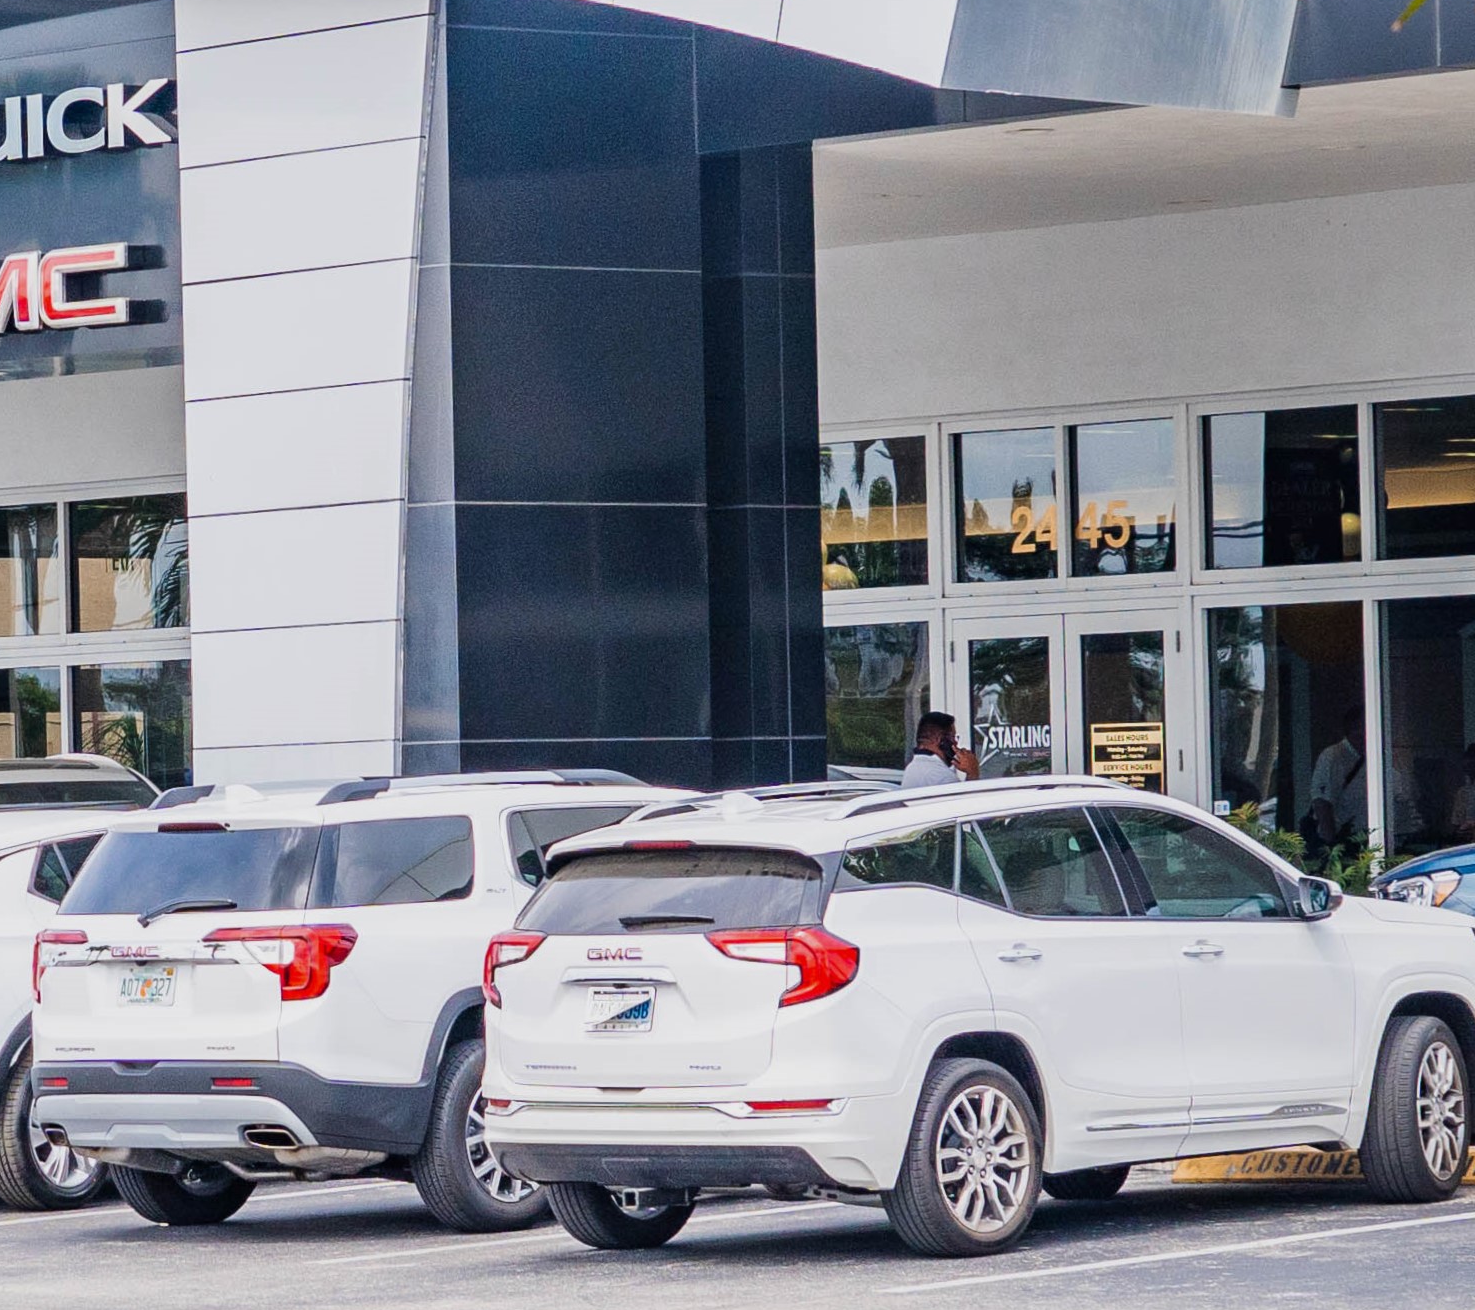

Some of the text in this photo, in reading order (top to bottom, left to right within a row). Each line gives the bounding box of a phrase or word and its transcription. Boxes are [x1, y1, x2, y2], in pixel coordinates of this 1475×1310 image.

[988, 725, 1050, 749] STARLING
[1106, 733, 1149, 742] SALES HOURS
[1103, 763, 1153, 772] SERVICE HOURS
[111, 946, 160, 958] GMC
[587, 948, 643, 960] GMC
[1240, 1151, 1367, 1176] CUSTOME
